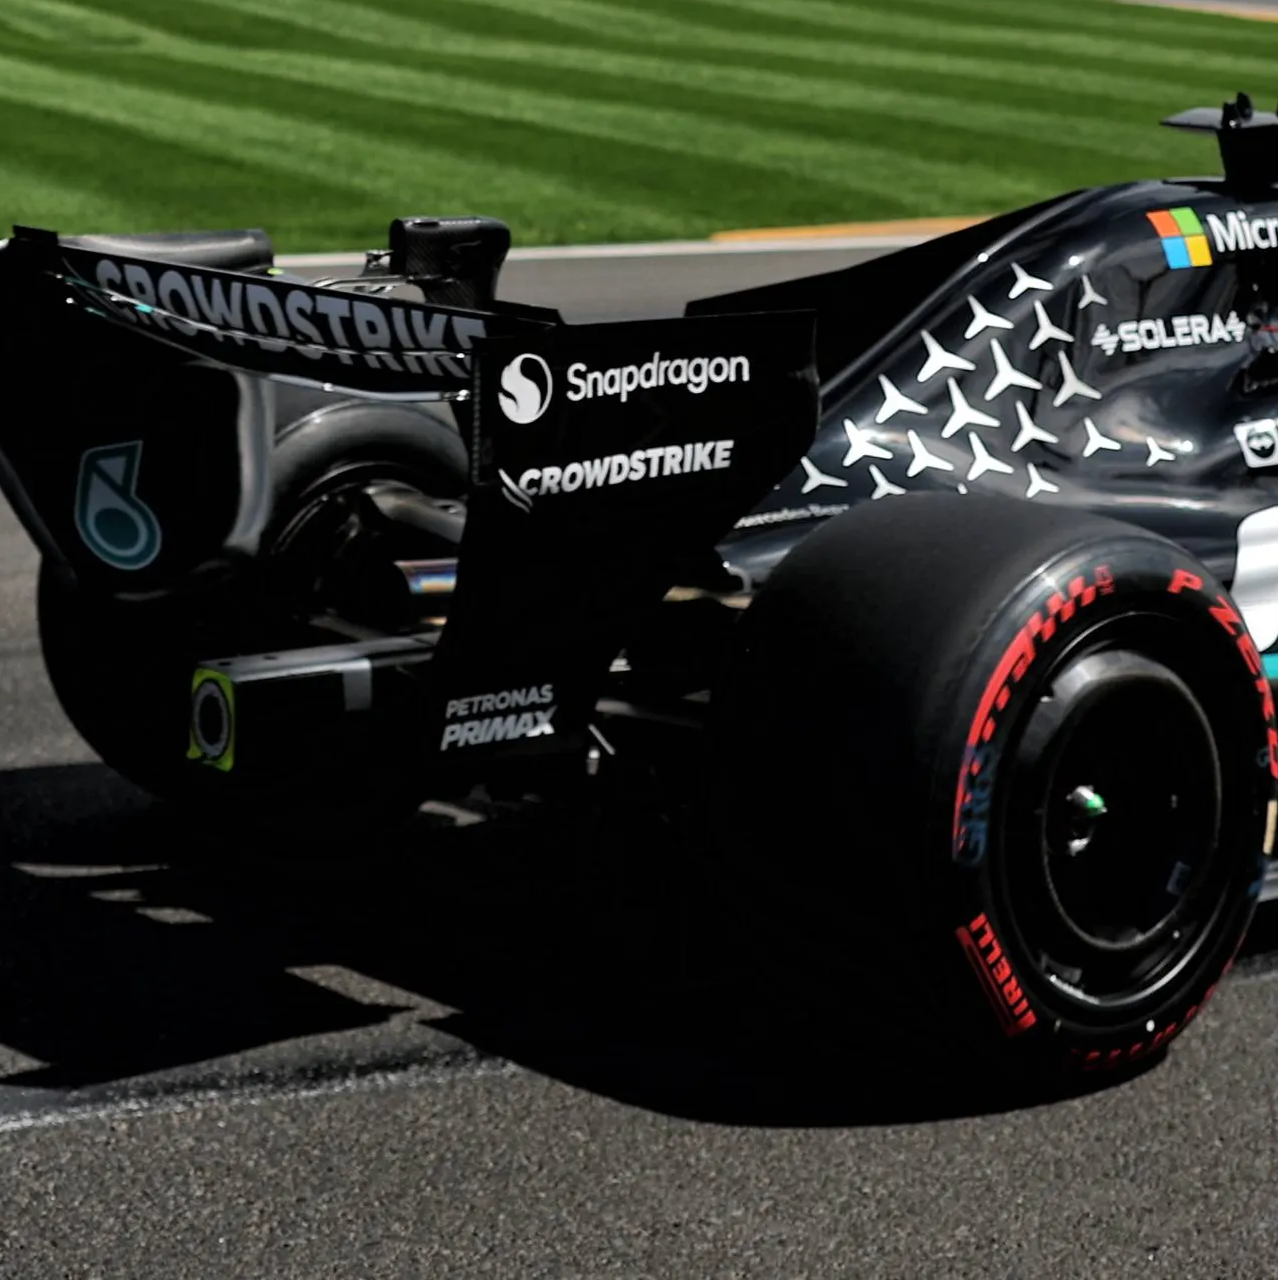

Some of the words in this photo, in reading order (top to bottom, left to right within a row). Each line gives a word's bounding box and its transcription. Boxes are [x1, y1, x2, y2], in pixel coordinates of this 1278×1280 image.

[1120, 313, 1228, 353] SOLERA
[566, 351, 751, 403] Snapdragon
[518, 439, 735, 496] CROWDSTRIKE
[445, 683, 554, 719] PETRONAS
[440, 703, 559, 751] PRIMAX
[955, 911, 1038, 1038] PIRELLI
